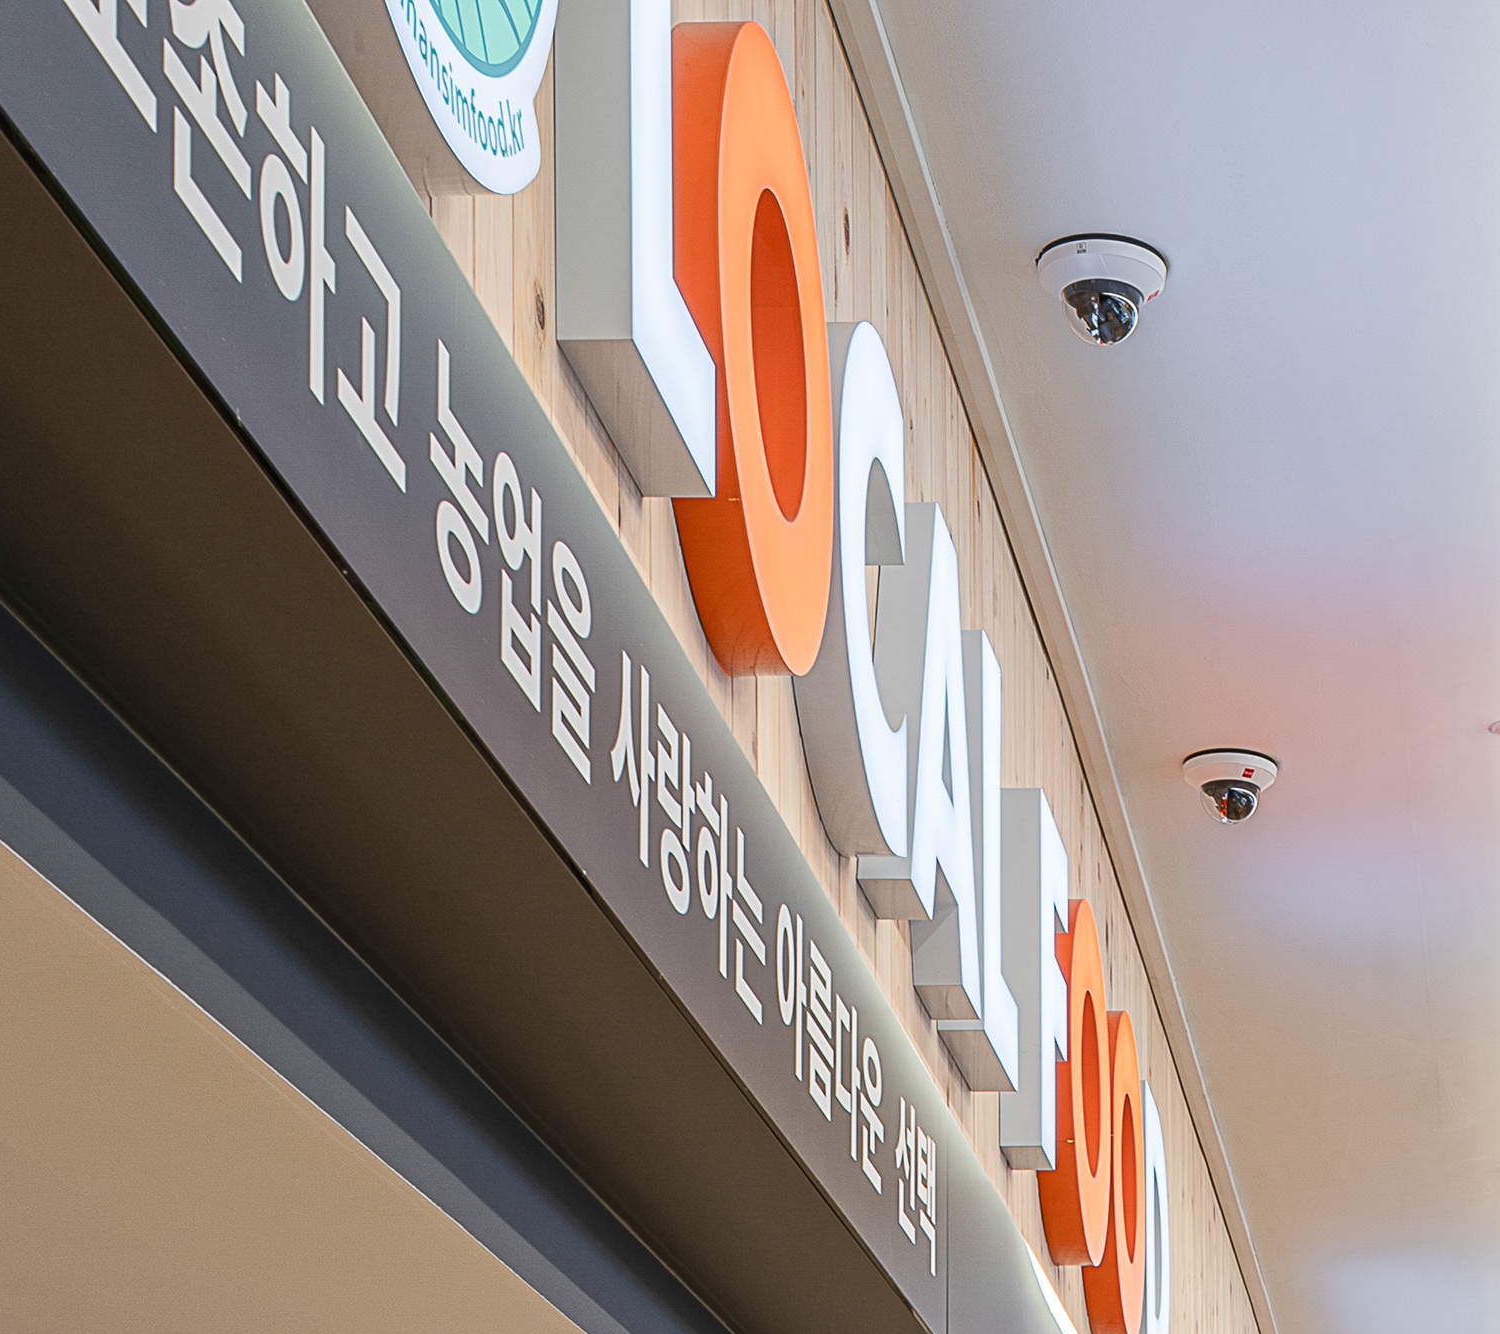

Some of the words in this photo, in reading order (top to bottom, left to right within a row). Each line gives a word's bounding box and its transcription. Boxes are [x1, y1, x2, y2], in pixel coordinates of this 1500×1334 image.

[399, 0, 525, 158] nansimfood.kr
[631, 0, 1018, 1092] LOCAL
[429, 338, 596, 786] 농업을
[611, 649, 767, 1026] 사랑하는
[776, 903, 885, 1196] 아름다운
[894, 1096, 938, 1278] 선택
